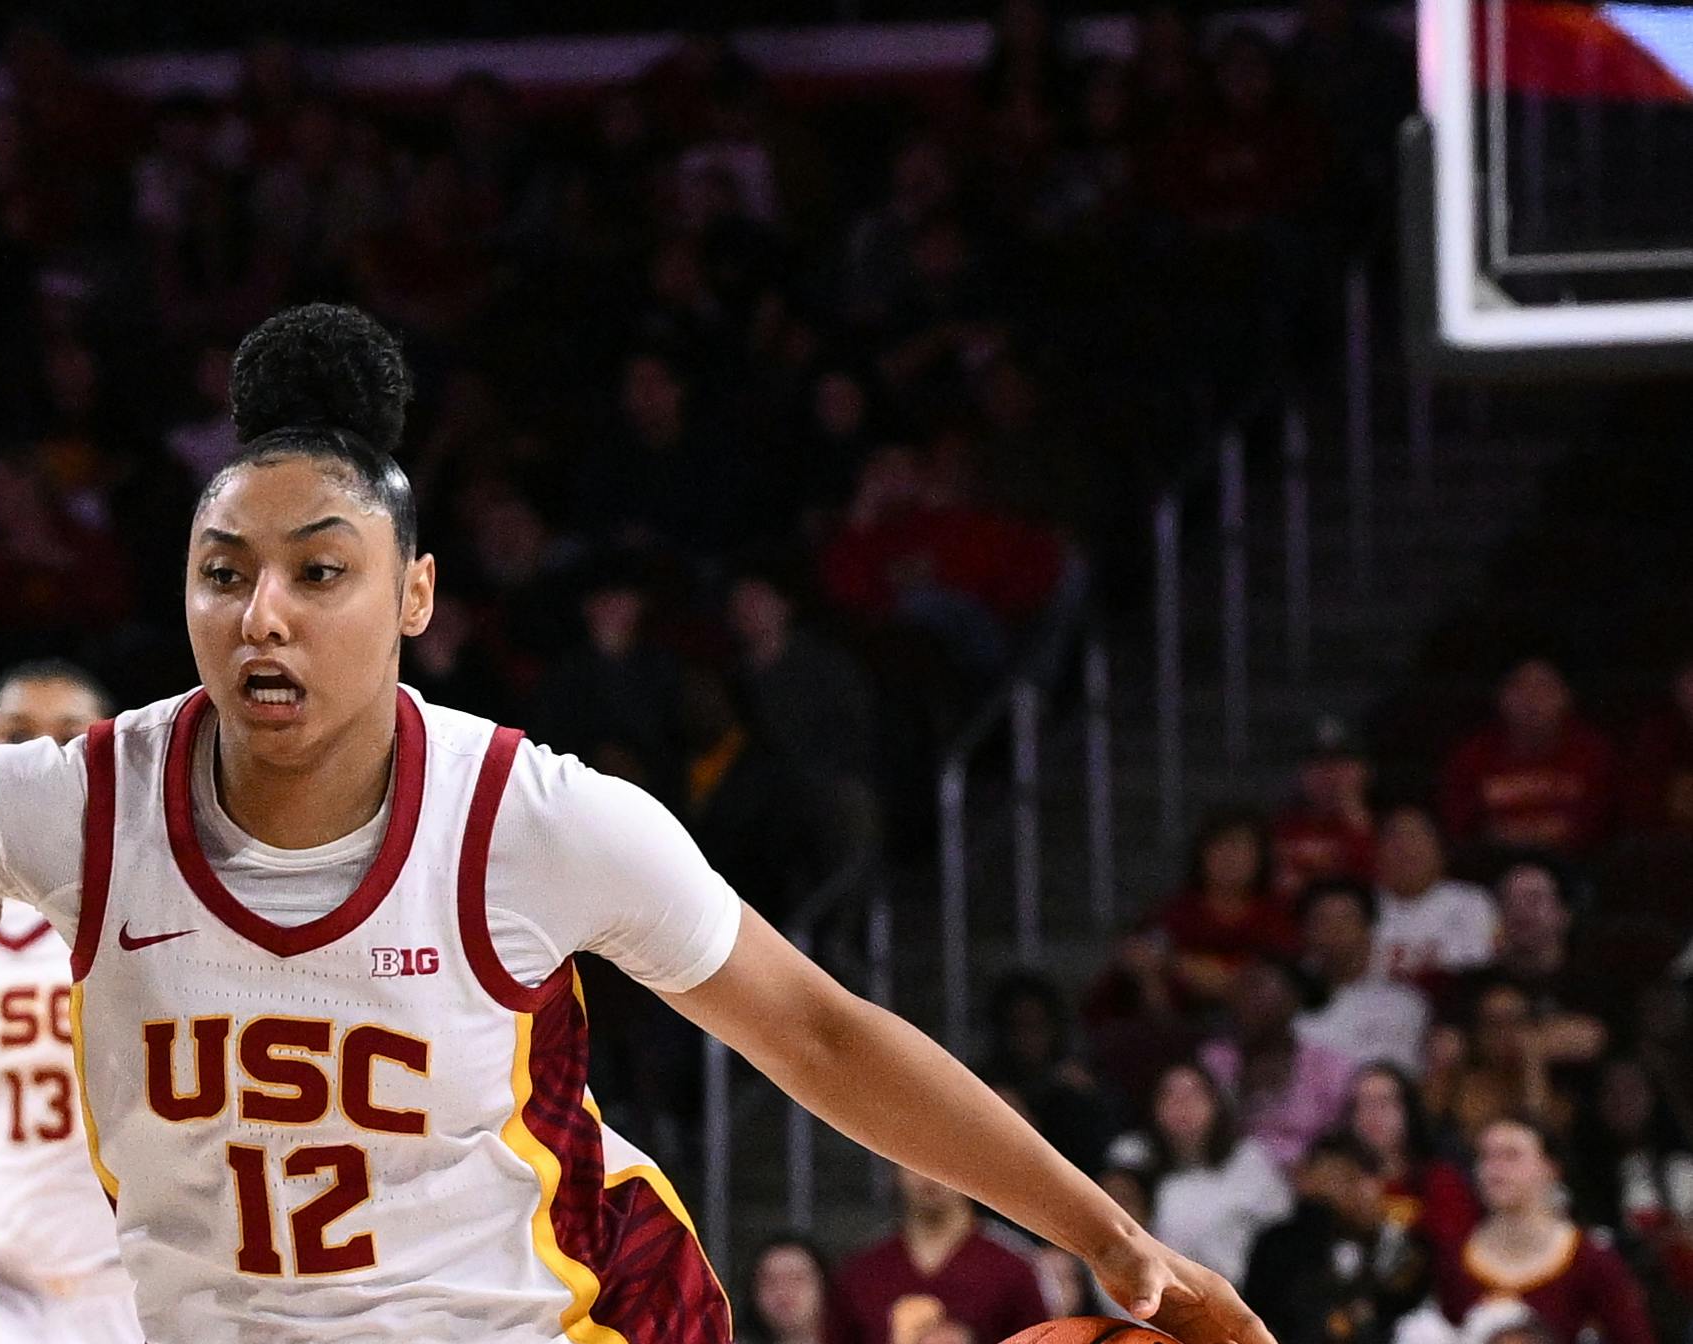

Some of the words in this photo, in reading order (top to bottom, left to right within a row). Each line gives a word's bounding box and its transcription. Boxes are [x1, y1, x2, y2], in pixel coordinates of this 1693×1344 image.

[3, 1067, 73, 1142] 13
[142, 1014, 432, 1138] USC
[226, 1141, 378, 1277] 12
